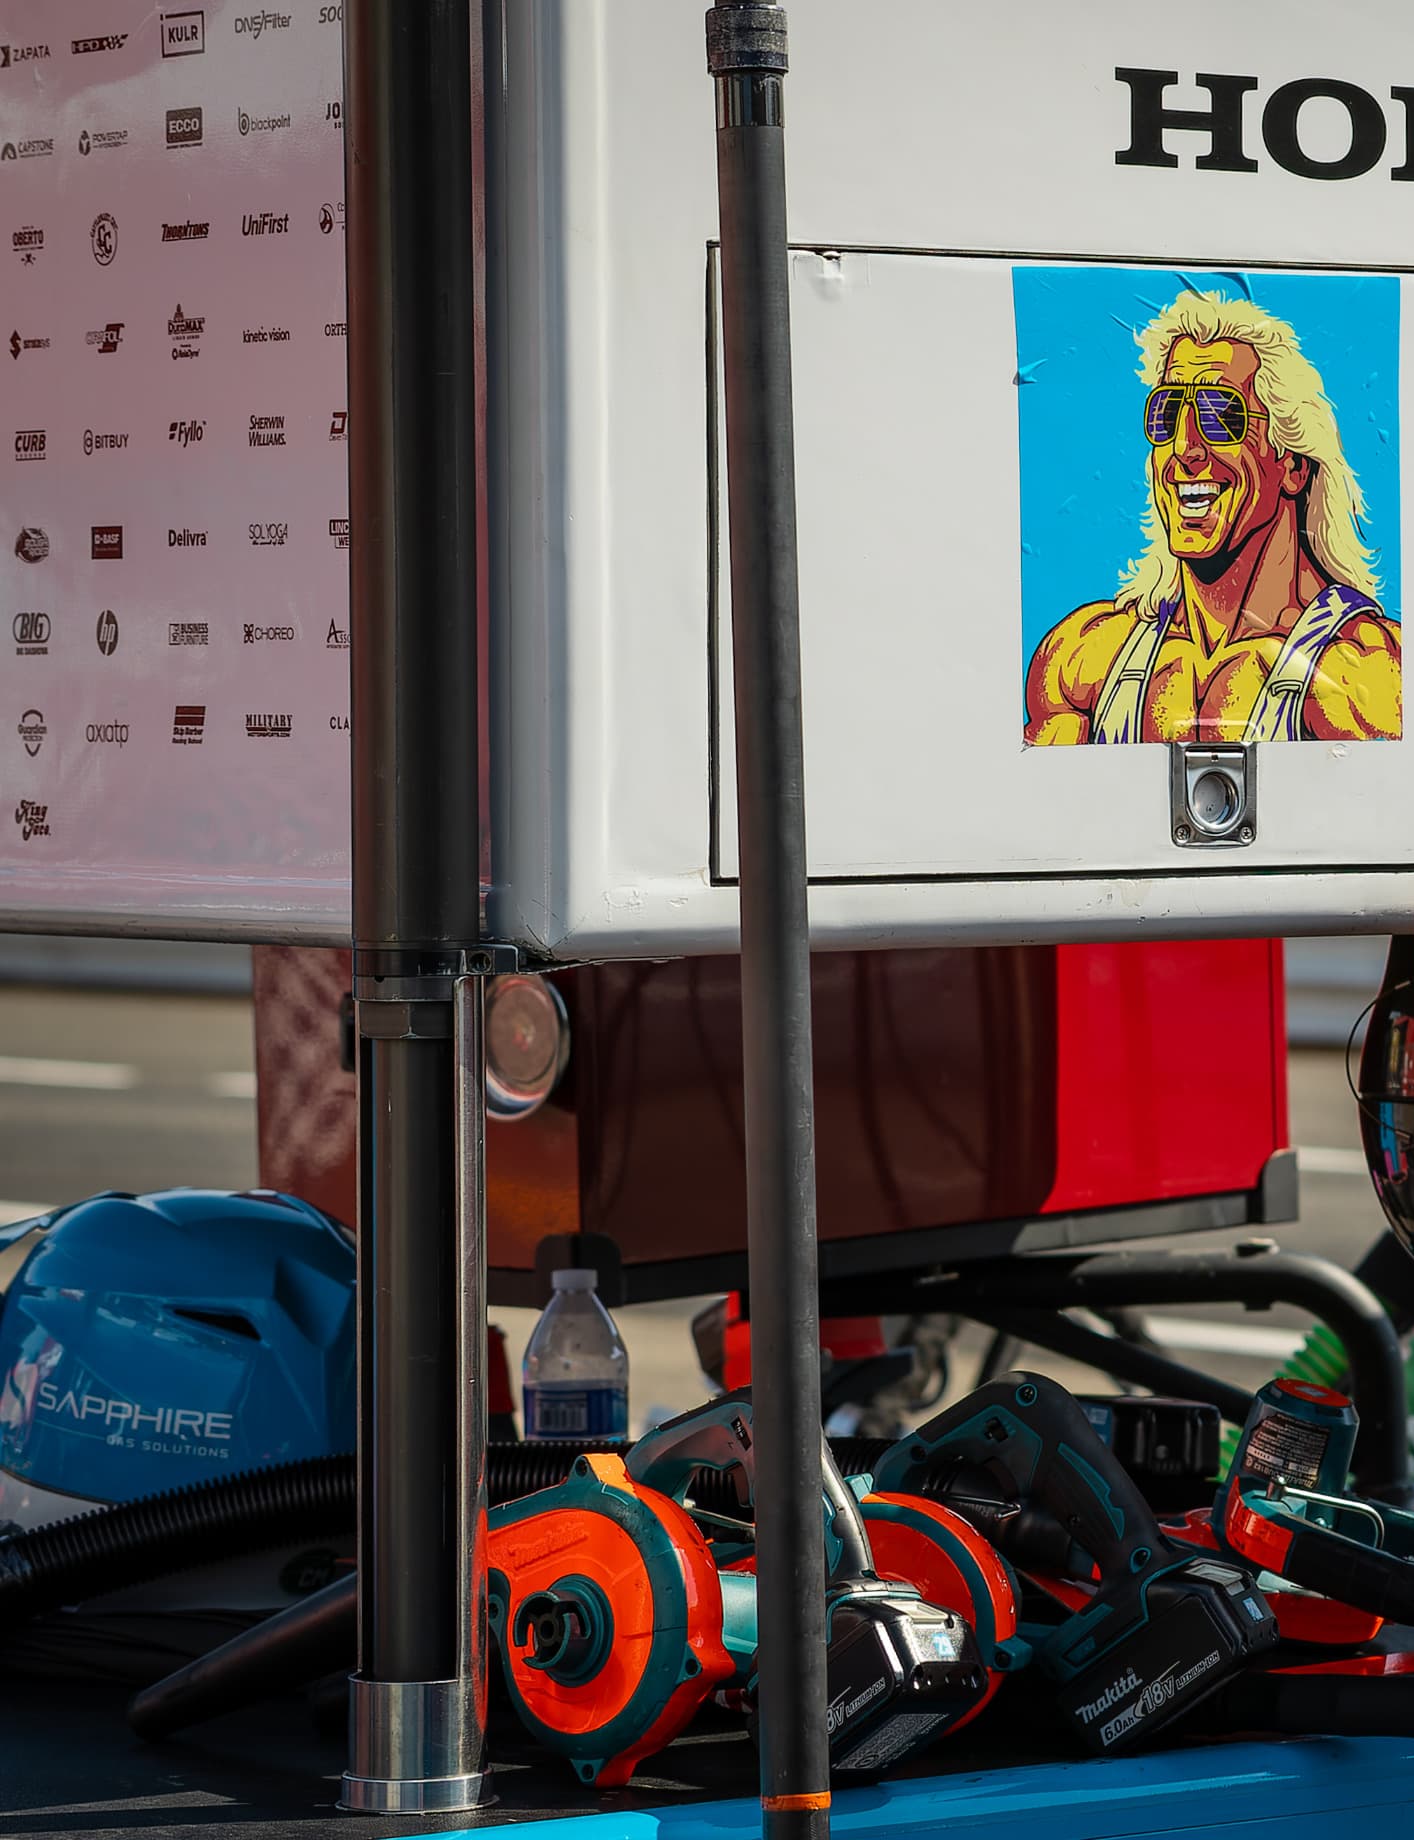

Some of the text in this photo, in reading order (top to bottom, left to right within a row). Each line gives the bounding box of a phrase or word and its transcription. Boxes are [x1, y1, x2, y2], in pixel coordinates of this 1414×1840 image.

[168, 25, 198, 43] KULR
[13, 46, 50, 61] ZAPATA
[169, 118, 199, 133] ECCO
[242, 213, 289, 236] UniFirst
[12, 229, 44, 246] OBERTO
[243, 326, 290, 343] kinetic vision
[249, 414, 285, 430] SHERWIN
[95, 433, 129, 449] BITBUY
[178, 420, 203, 448] Fyllo
[15, 434, 46, 452] CURB
[168, 529, 206, 546] Delivra
[20, 612, 43, 640] BIG
[254, 627, 294, 640] CHOREO
[245, 714, 293, 727] MILITARY
[37, 1382, 233, 1440] SAPPHIRE
[142, 1440, 229, 1459] SOLUTIONS
[1103, 1716, 1135, 1742] 6.0Ah
[1142, 1676, 1175, 1714] 18V
